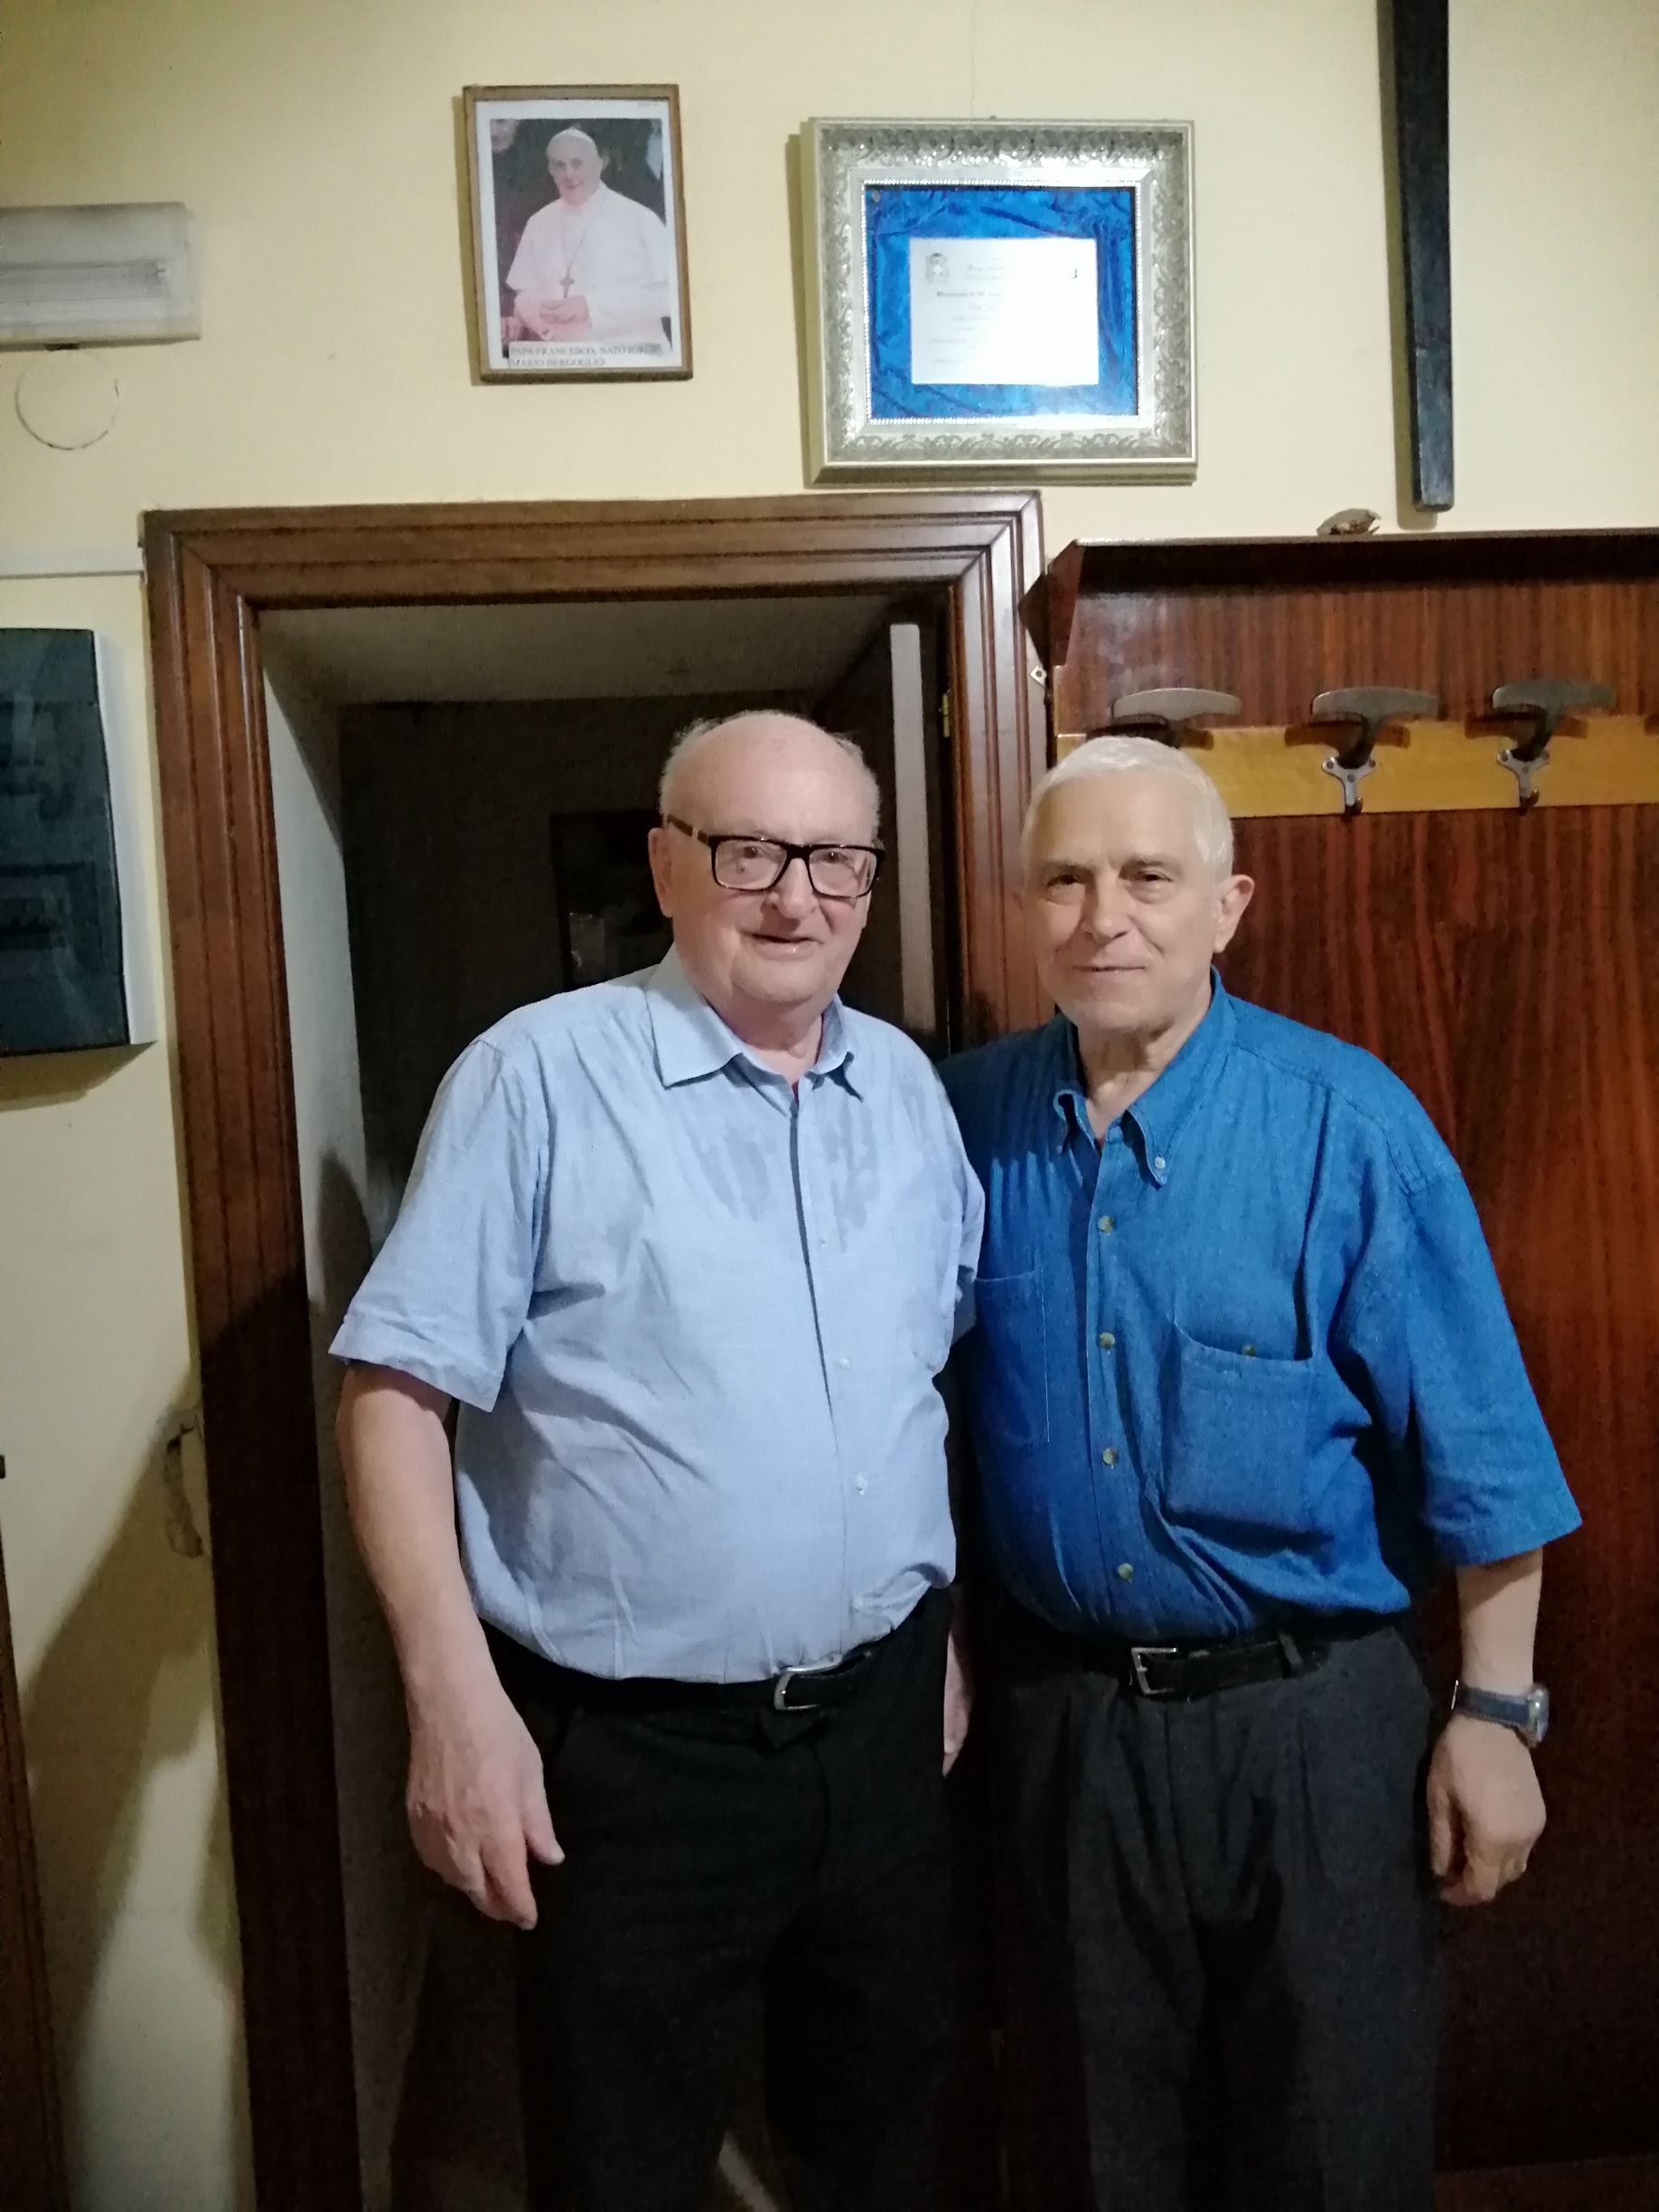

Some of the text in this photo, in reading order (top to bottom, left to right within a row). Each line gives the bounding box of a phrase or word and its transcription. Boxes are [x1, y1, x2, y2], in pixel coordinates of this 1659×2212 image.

[511, 347, 534, 356] PAPA
[599, 345, 625, 355] NATO
[511, 358, 545, 367] MARIO
